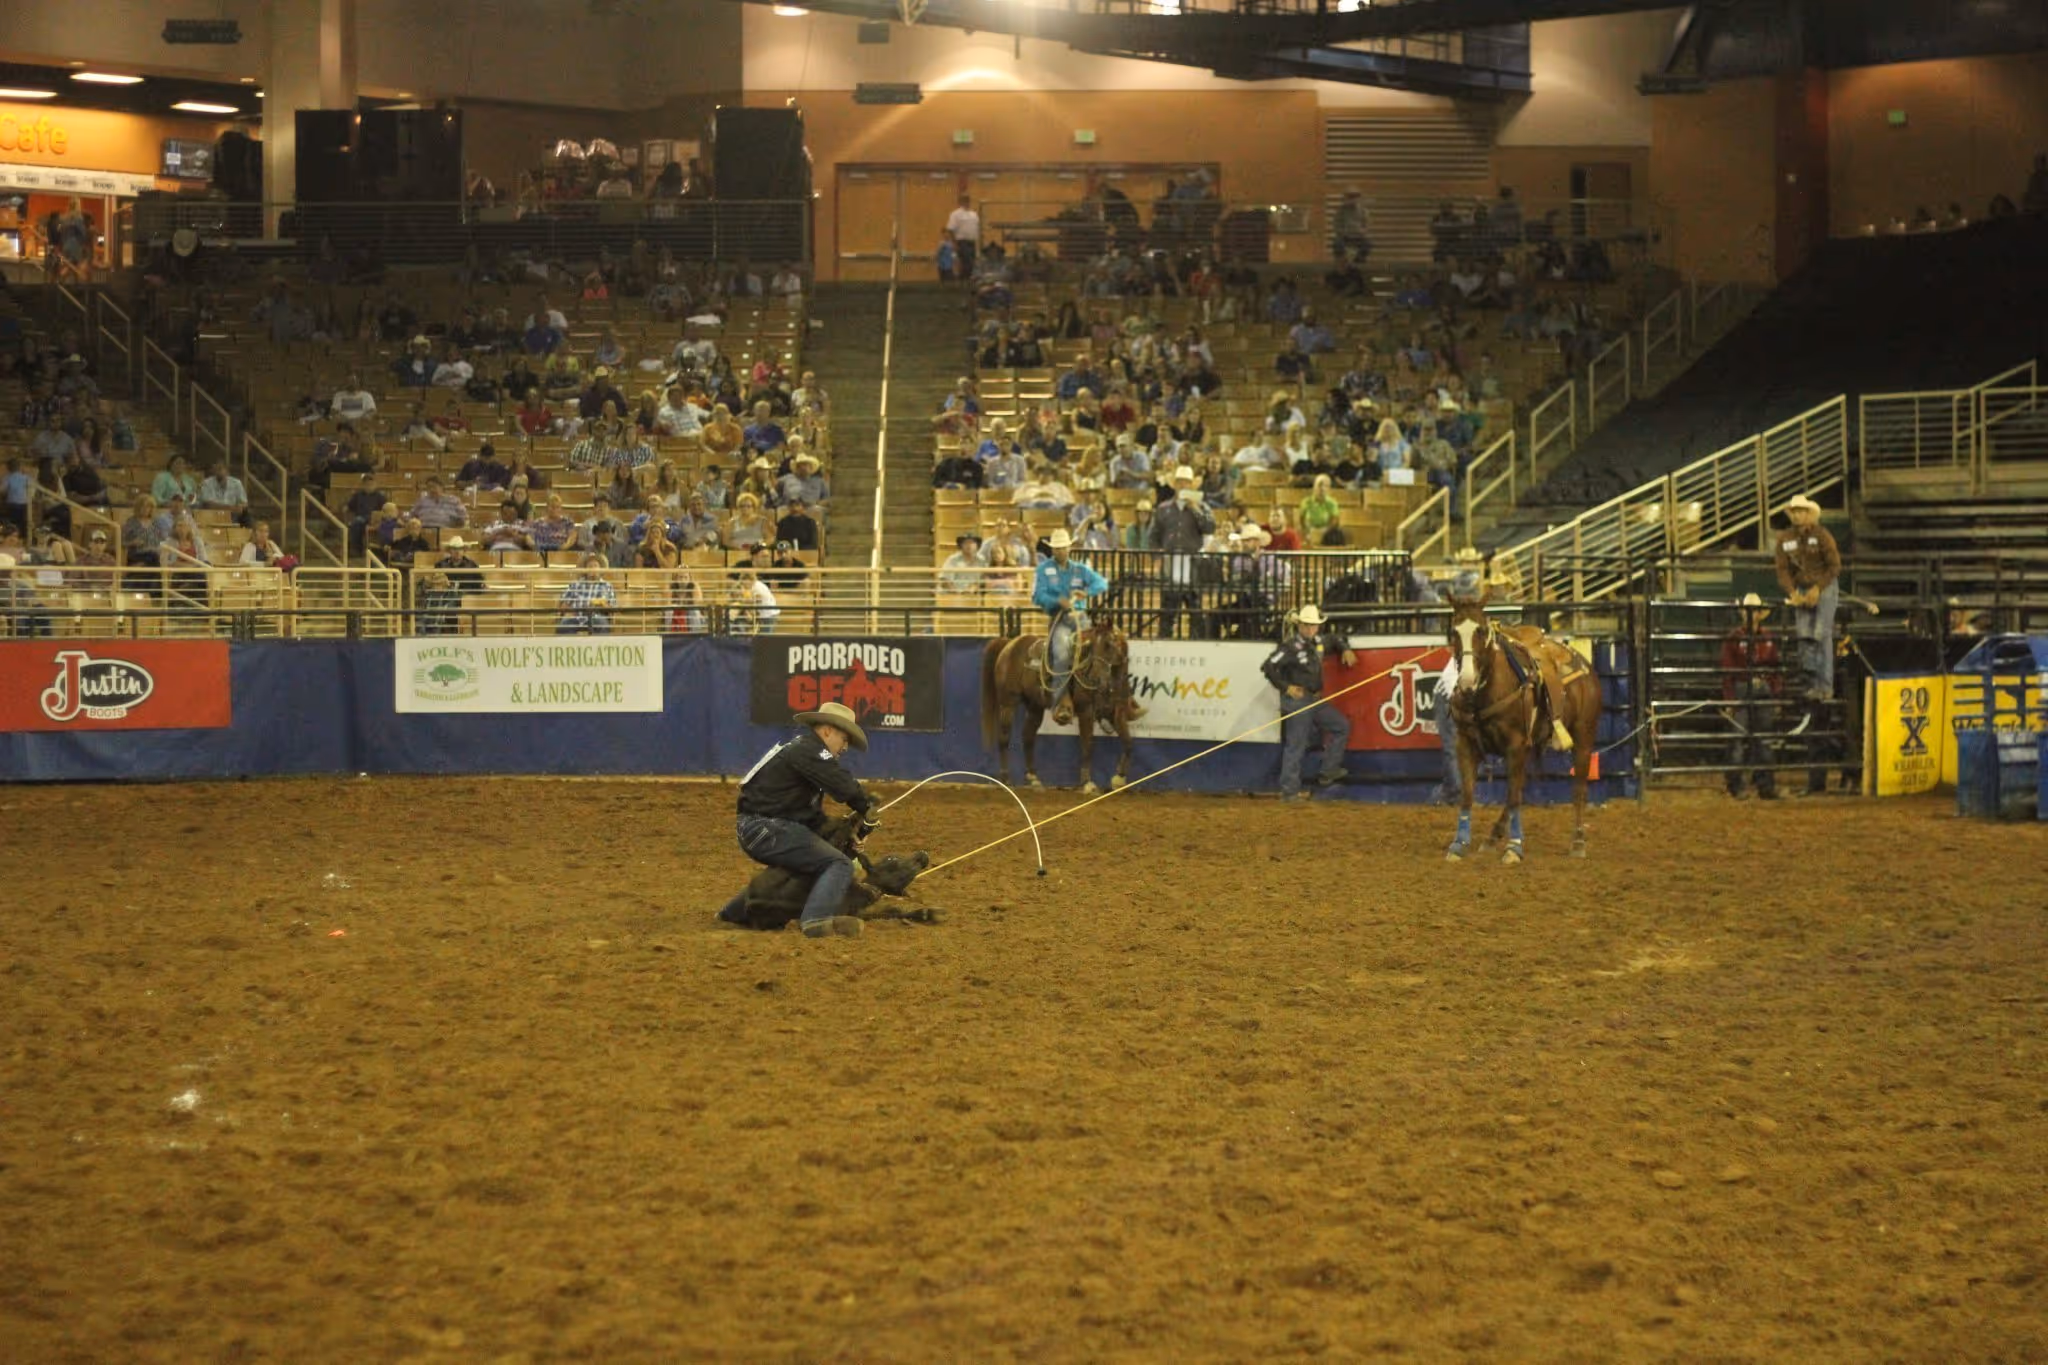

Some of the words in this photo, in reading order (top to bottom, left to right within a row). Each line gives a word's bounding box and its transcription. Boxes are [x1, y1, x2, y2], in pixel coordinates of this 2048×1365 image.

[416, 646, 475, 662] WOLF'S
[484, 646, 544, 668] WOLF'S
[549, 645, 645, 667] IRRIGATION
[788, 642, 905, 676] PRORODEO
[41, 651, 143, 721] Justin
[510, 681, 523, 703] &
[527, 681, 624, 703] LANDSCAPE
[1900, 687, 1929, 714] 20
[89, 707, 125, 718] BOOTS
[881, 714, 905, 726] .COM
[1900, 716, 1930, 757] X
